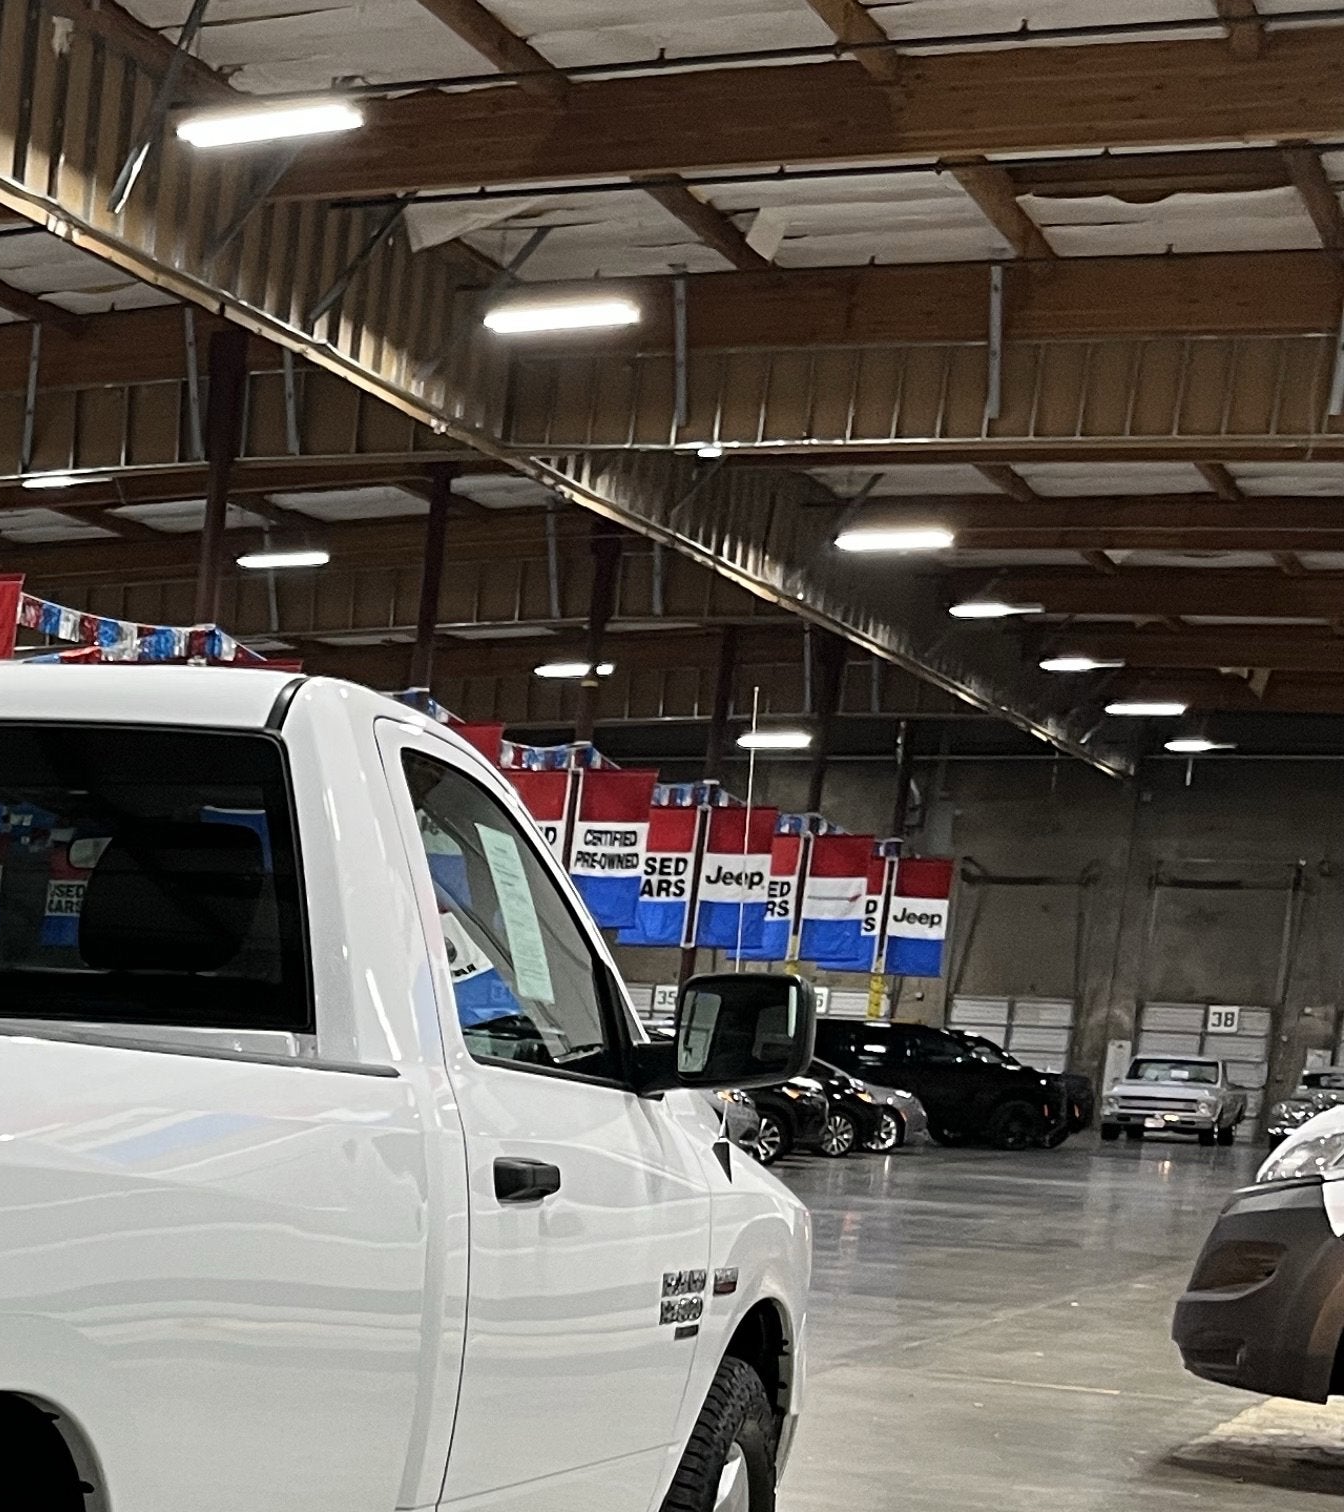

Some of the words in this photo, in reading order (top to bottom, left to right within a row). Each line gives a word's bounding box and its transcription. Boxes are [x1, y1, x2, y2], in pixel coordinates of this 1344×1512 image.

[574, 850, 639, 870] PRE-OWNED
[644, 857, 688, 876] SED
[705, 865, 763, 890] Jeep
[640, 879, 685, 898] ARS
[768, 881, 791, 898] ED
[766, 900, 789, 917] RS
[893, 908, 942, 928] Jeep
[1211, 1011, 1236, 1028] 38
